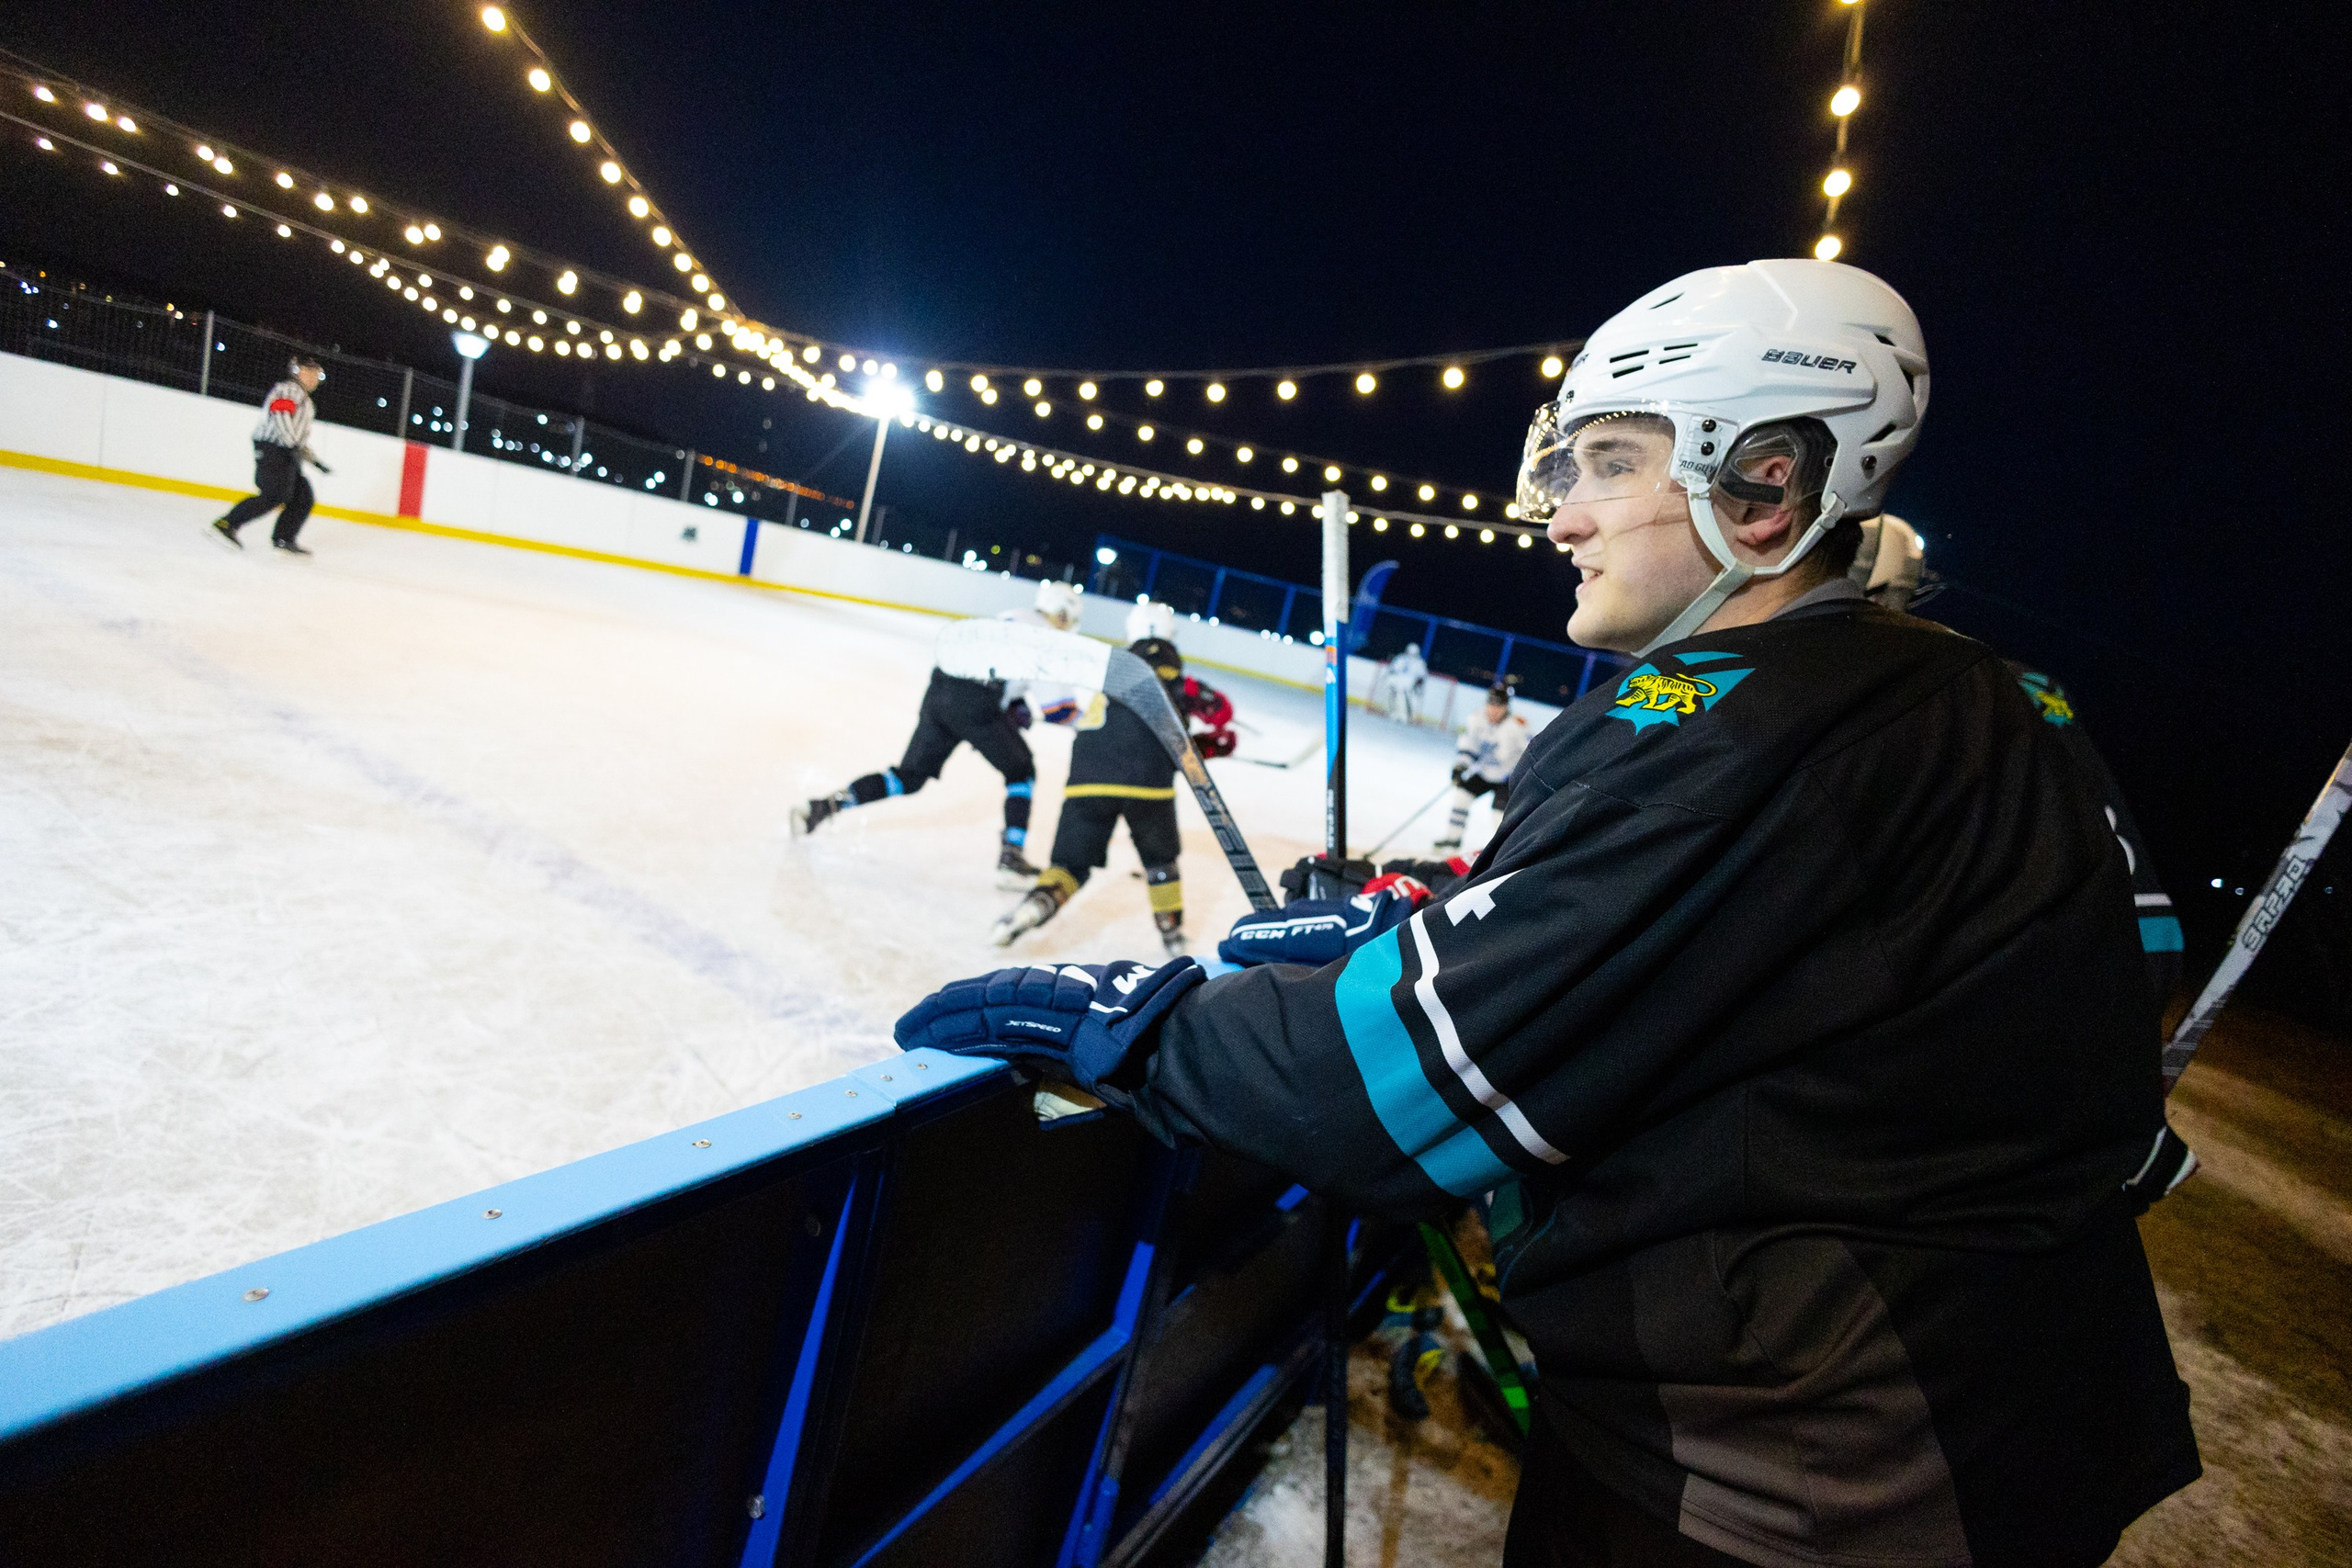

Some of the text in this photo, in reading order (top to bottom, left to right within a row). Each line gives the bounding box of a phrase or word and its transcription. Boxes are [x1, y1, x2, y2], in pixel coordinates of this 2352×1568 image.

[1761, 348, 1857, 374] BAUER
[1240, 929, 1286, 941] CCM
[1005, 1020, 1062, 1033] JETSPEED
